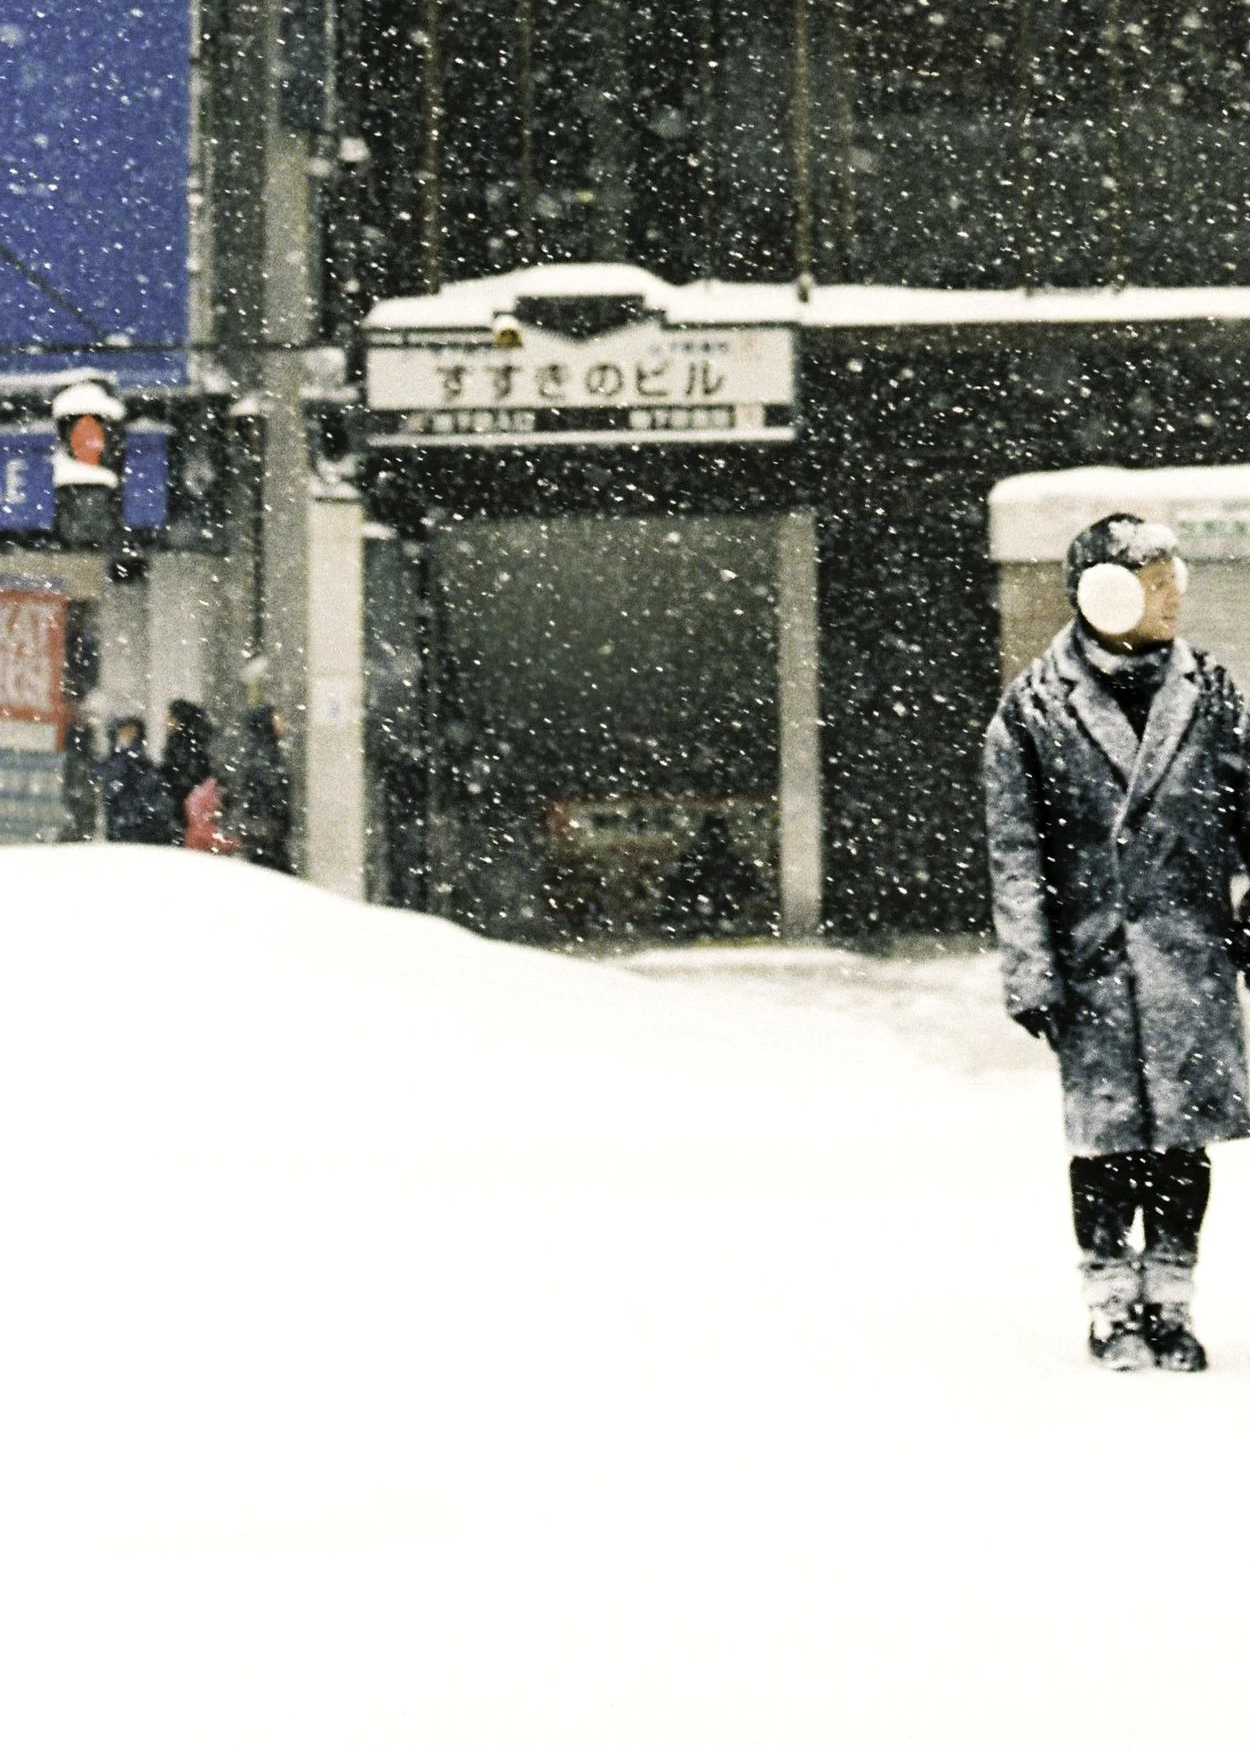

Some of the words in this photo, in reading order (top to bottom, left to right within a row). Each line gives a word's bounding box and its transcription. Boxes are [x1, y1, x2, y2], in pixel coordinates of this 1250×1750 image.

[436, 361, 725, 401] すすきのビル
